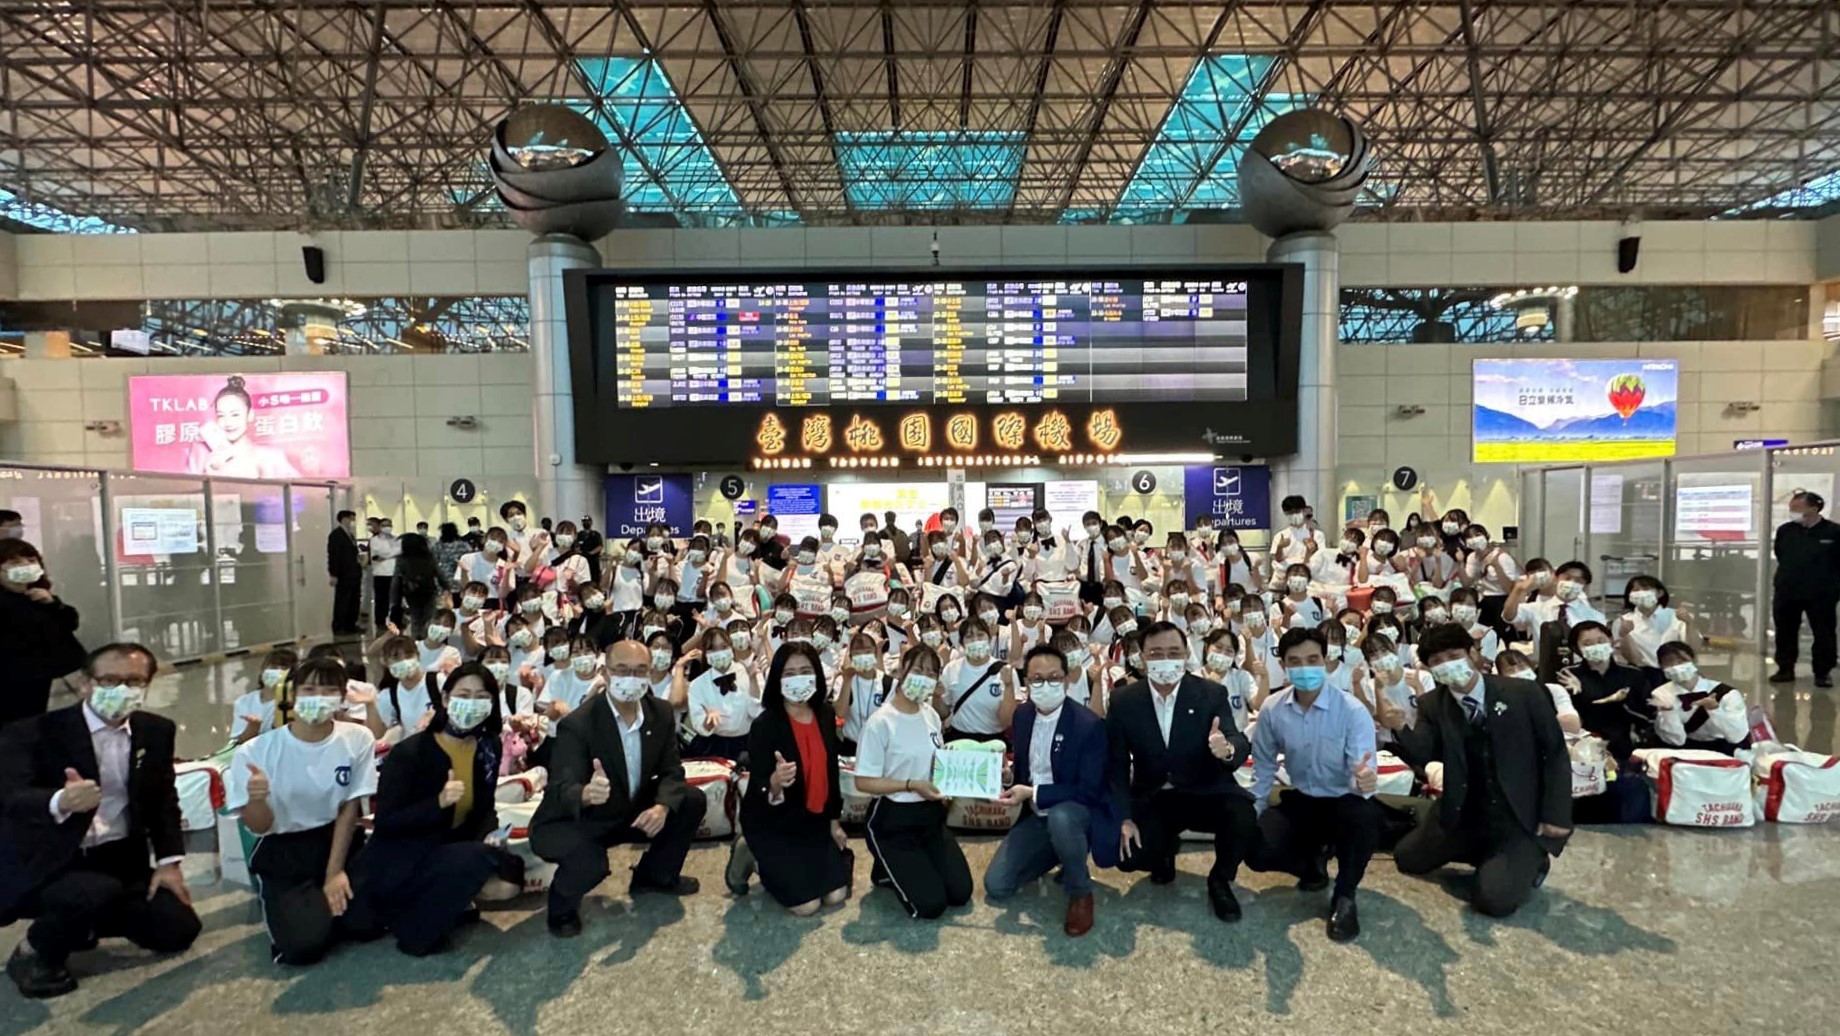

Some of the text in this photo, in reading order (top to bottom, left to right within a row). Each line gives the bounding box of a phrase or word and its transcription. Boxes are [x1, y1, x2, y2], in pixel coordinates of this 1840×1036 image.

[150, 398, 208, 411] TKLAB
[753, 457, 811, 469] TAIWAN
[829, 456, 899, 469] TAOYUAN
[917, 454, 1040, 467] INTERNATIONAL
[1139, 474, 1150, 490] 6
[1401, 471, 1410, 486] 7
[456, 483, 467, 499] 4
[727, 480, 738, 496] 5
[634, 506, 666, 522] 出境
[1213, 499, 1243, 514] 出境
[1211, 517, 1257, 528] partures
[1695, 812, 1719, 825] SHS
